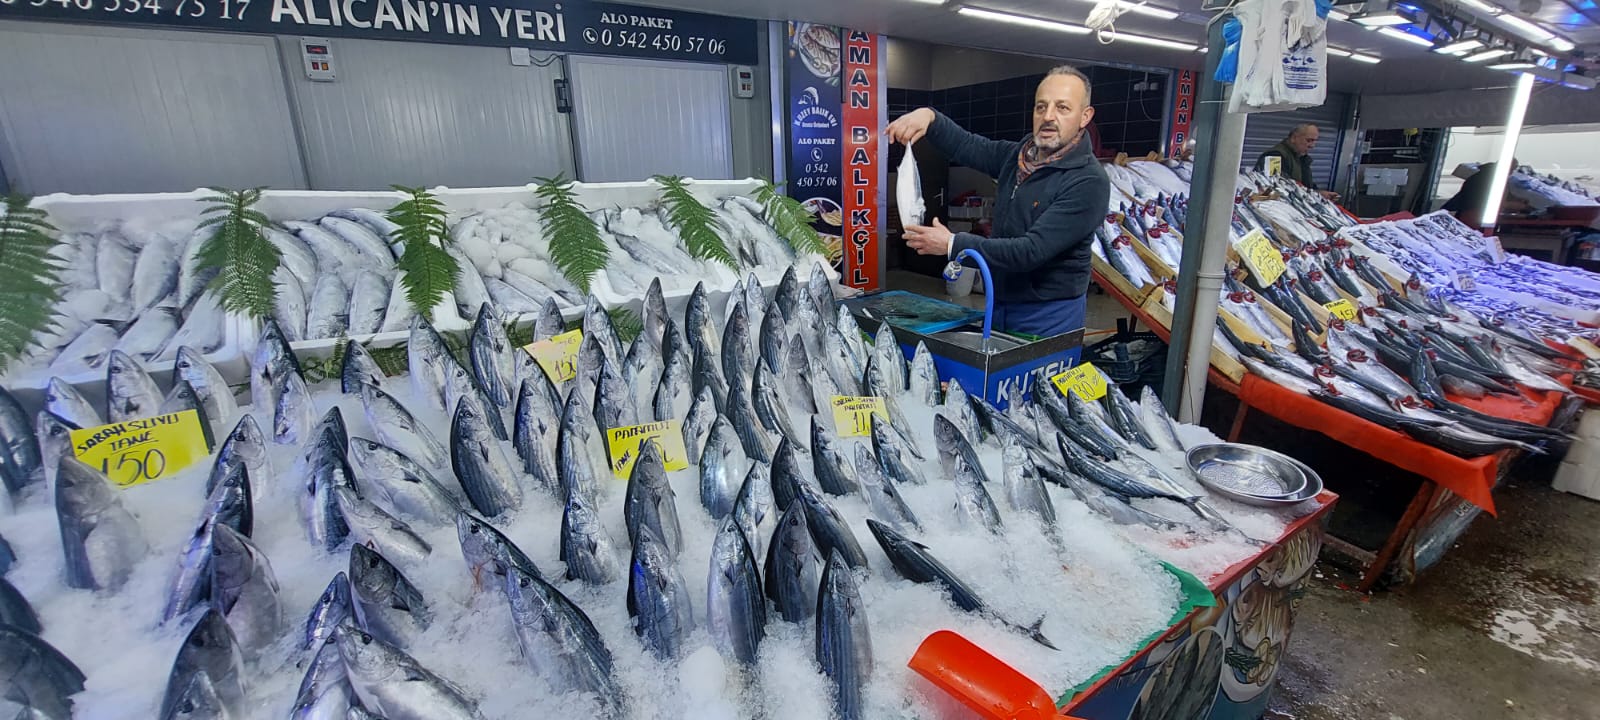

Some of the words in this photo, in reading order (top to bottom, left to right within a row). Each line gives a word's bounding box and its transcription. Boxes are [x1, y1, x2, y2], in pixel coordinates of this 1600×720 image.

[219, 0, 251, 20] 17
[489, 3, 566, 42] YERİ
[600, 12, 628, 25] ALO
[630, 15, 673, 30] PAKET
[601, 29, 612, 46] 0
[617, 30, 647, 48] 542
[652, 34, 681, 52] 450
[685, 37, 705, 53] 57
[708, 38, 726, 55] 06
[1177, 69, 1191, 124] AMAN
[805, 163, 811, 173] 0
[813, 163, 829, 173] 542
[797, 177, 813, 187] 450
[814, 177, 825, 187] 57
[826, 177, 837, 187] 06
[111, 431, 152, 451] TANE
[102, 448, 166, 486] 150
